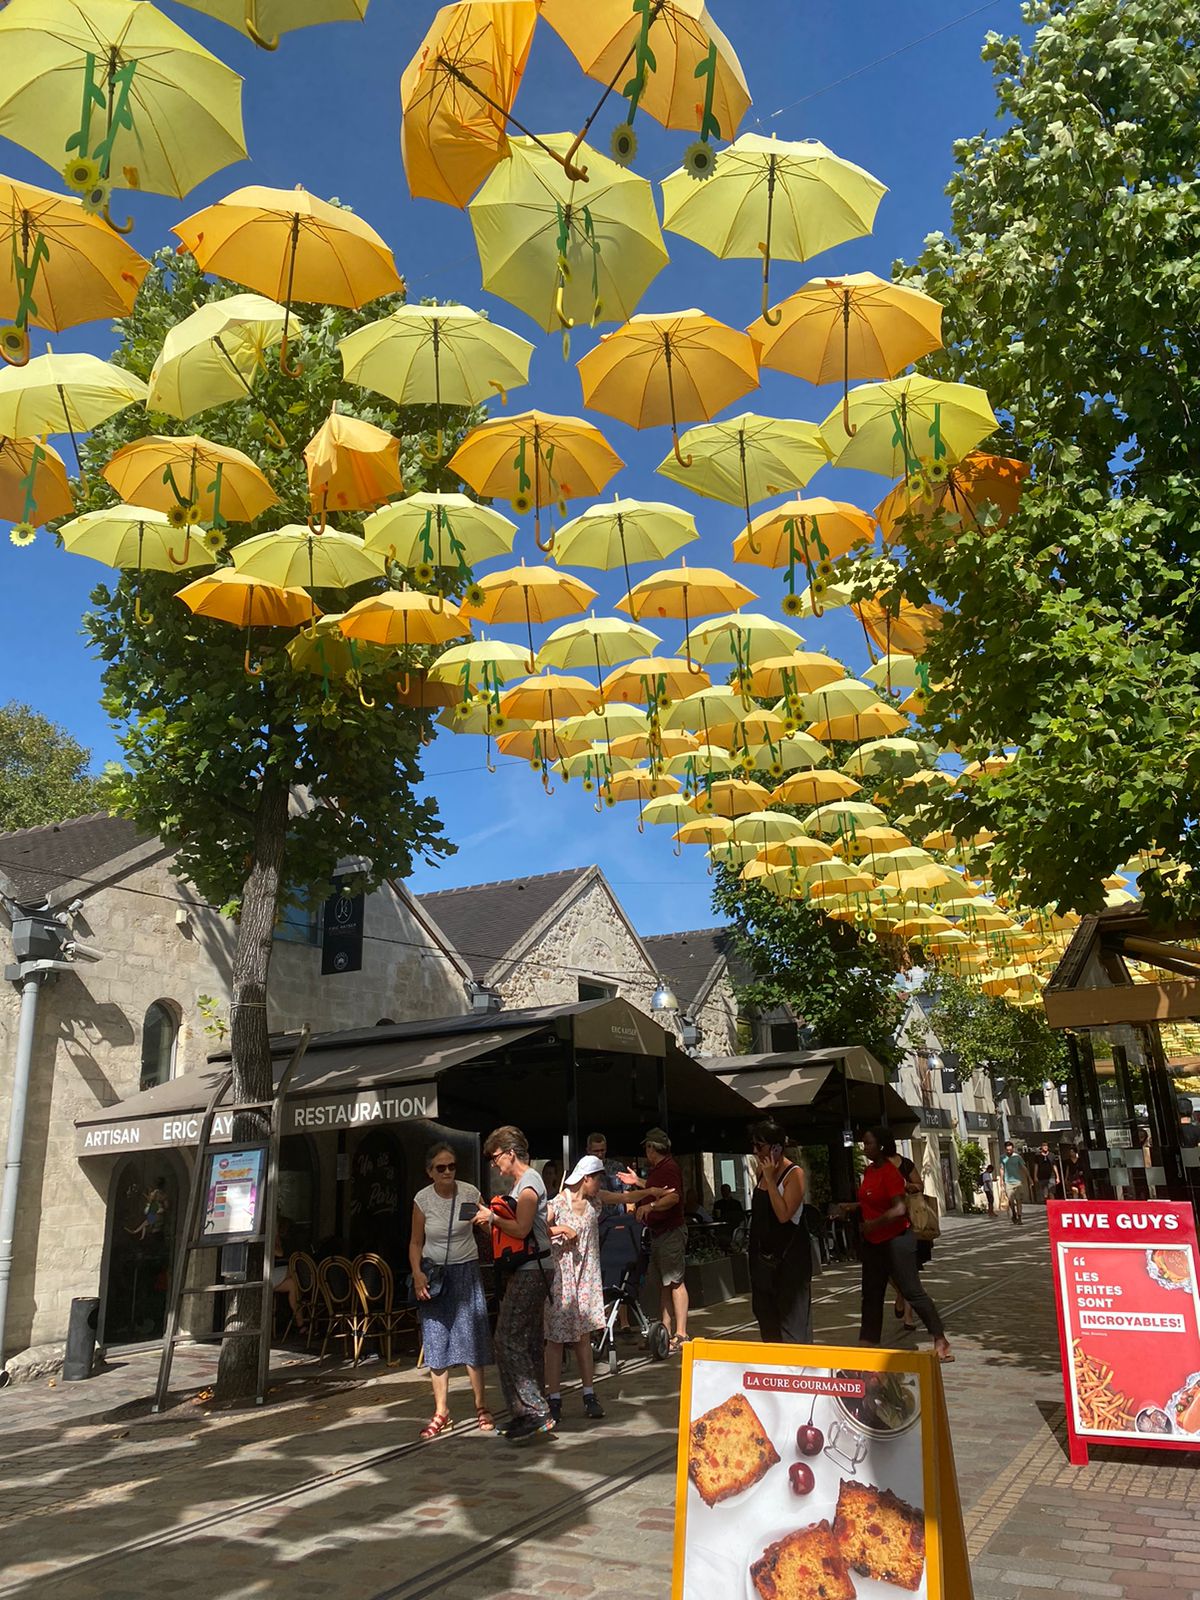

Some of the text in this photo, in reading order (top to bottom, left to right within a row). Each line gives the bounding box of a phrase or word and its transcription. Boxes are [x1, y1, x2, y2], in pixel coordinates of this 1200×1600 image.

[294, 1096, 427, 1126] RESTAURATION
[85, 1116, 233, 1147] ARTISAN ERIC AY
[1061, 1213, 1178, 1230] FIVE GUYS
[1074, 1272, 1099, 1282] LES
[1076, 1284, 1123, 1296] FRITES
[1077, 1297, 1114, 1308] SONT
[1082, 1314, 1182, 1328] INCROYABLES!
[747, 1376, 862, 1393] LA CURE GOURMANDE
